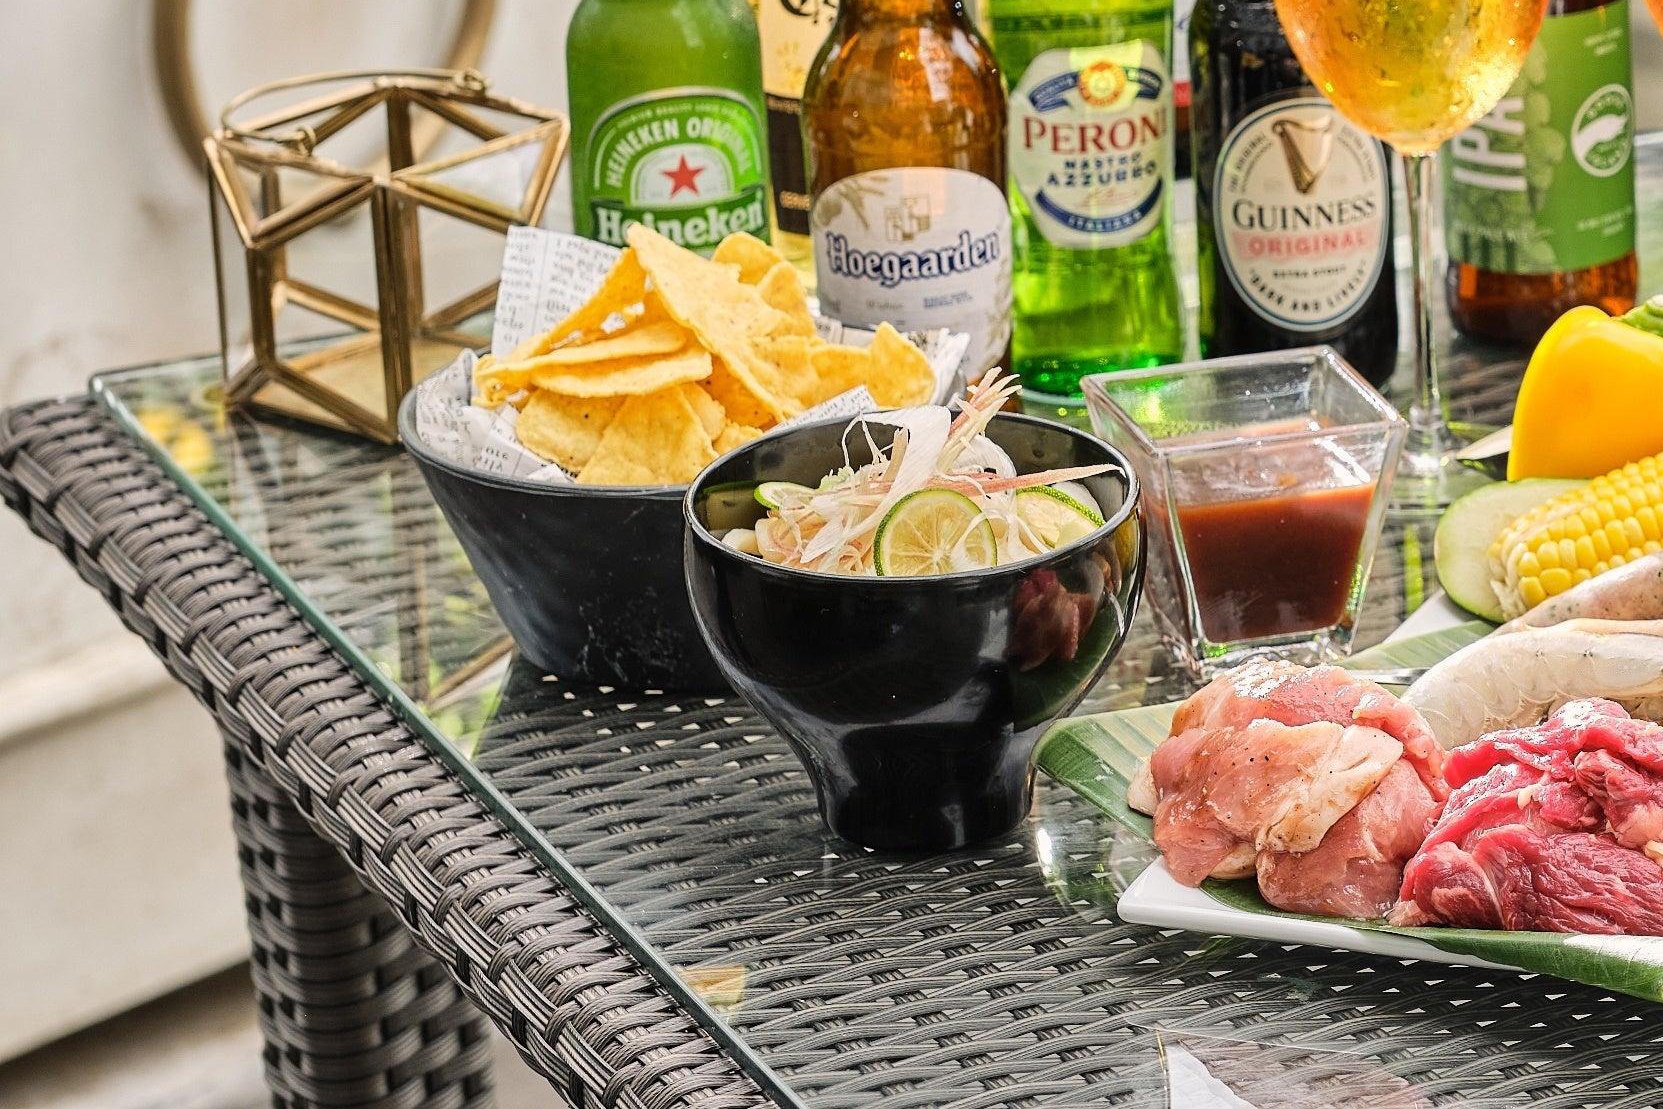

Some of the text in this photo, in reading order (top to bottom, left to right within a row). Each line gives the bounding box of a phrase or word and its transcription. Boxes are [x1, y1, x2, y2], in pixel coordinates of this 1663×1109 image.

[606, 117, 680, 188] HEINEKEN
[1452, 96, 1528, 192] IPA
[1232, 194, 1376, 232] GUINNESS
[826, 229, 1001, 289] Hoegaarden
[1247, 231, 1367, 256] ORIGINAL
